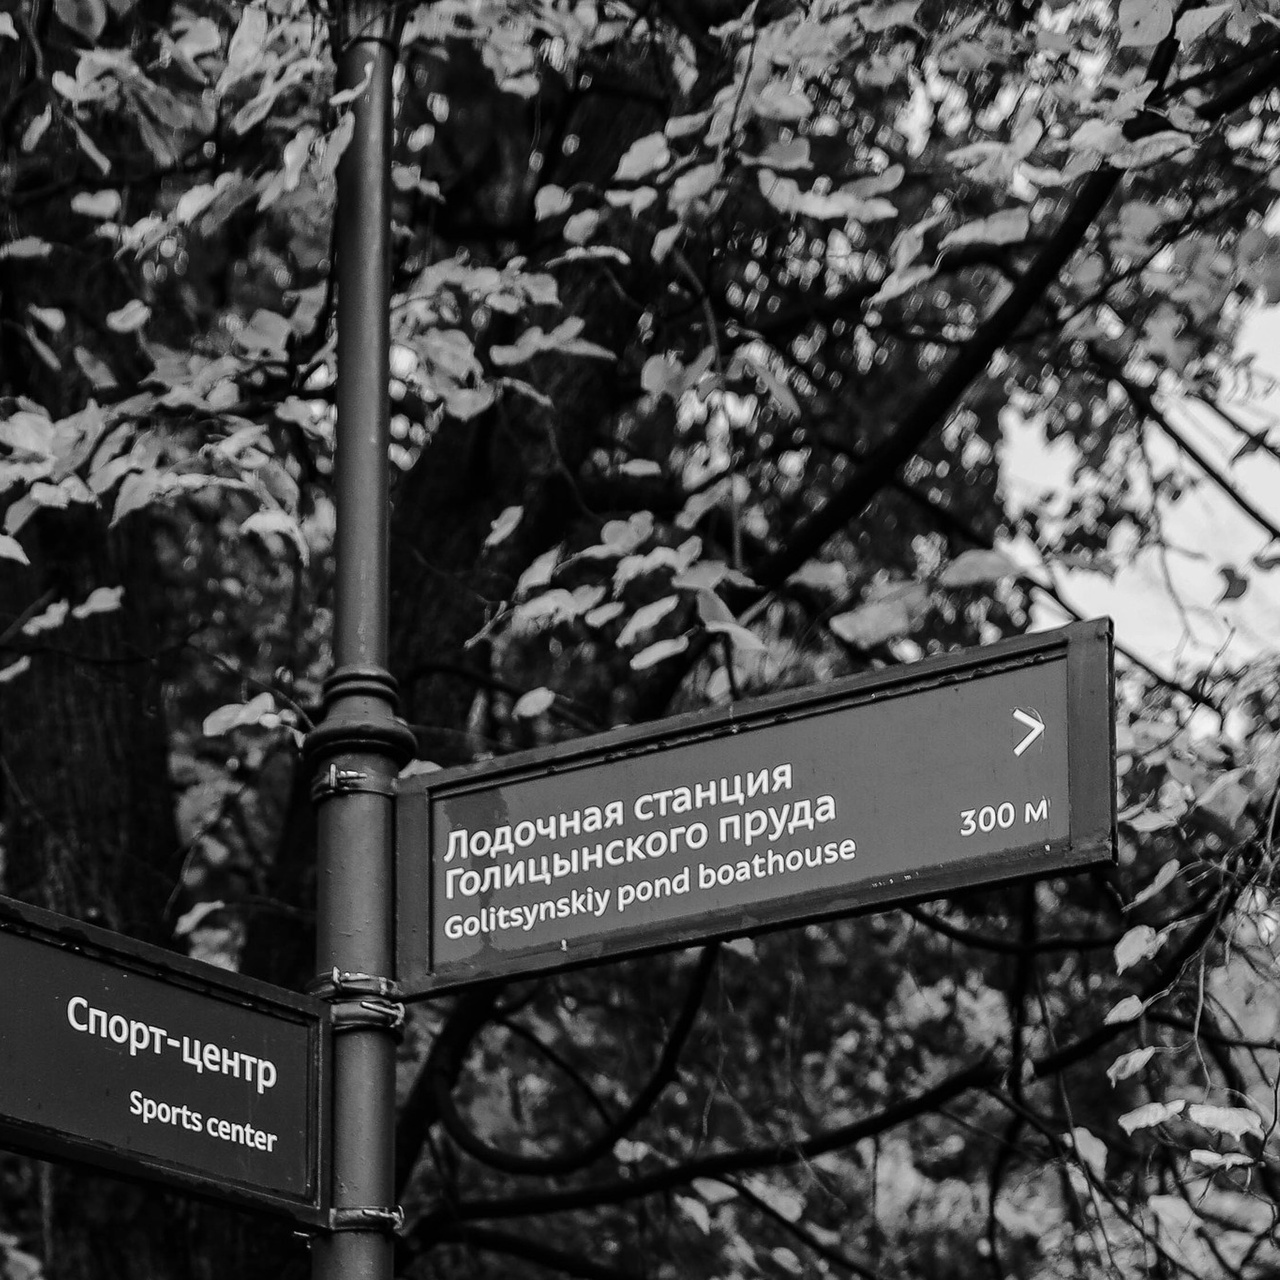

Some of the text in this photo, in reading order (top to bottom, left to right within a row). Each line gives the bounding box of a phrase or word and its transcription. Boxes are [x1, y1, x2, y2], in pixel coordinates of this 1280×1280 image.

[443, 763, 792, 863] Лодочная станция
[446, 795, 836, 900] Голицынского пруда
[960, 799, 1048, 836] 300 м
[444, 839, 856, 939] Golitsynskiy pond boathouse
[67, 996, 277, 1095] Спорт-центр
[129, 1090, 278, 1153] Sports center
